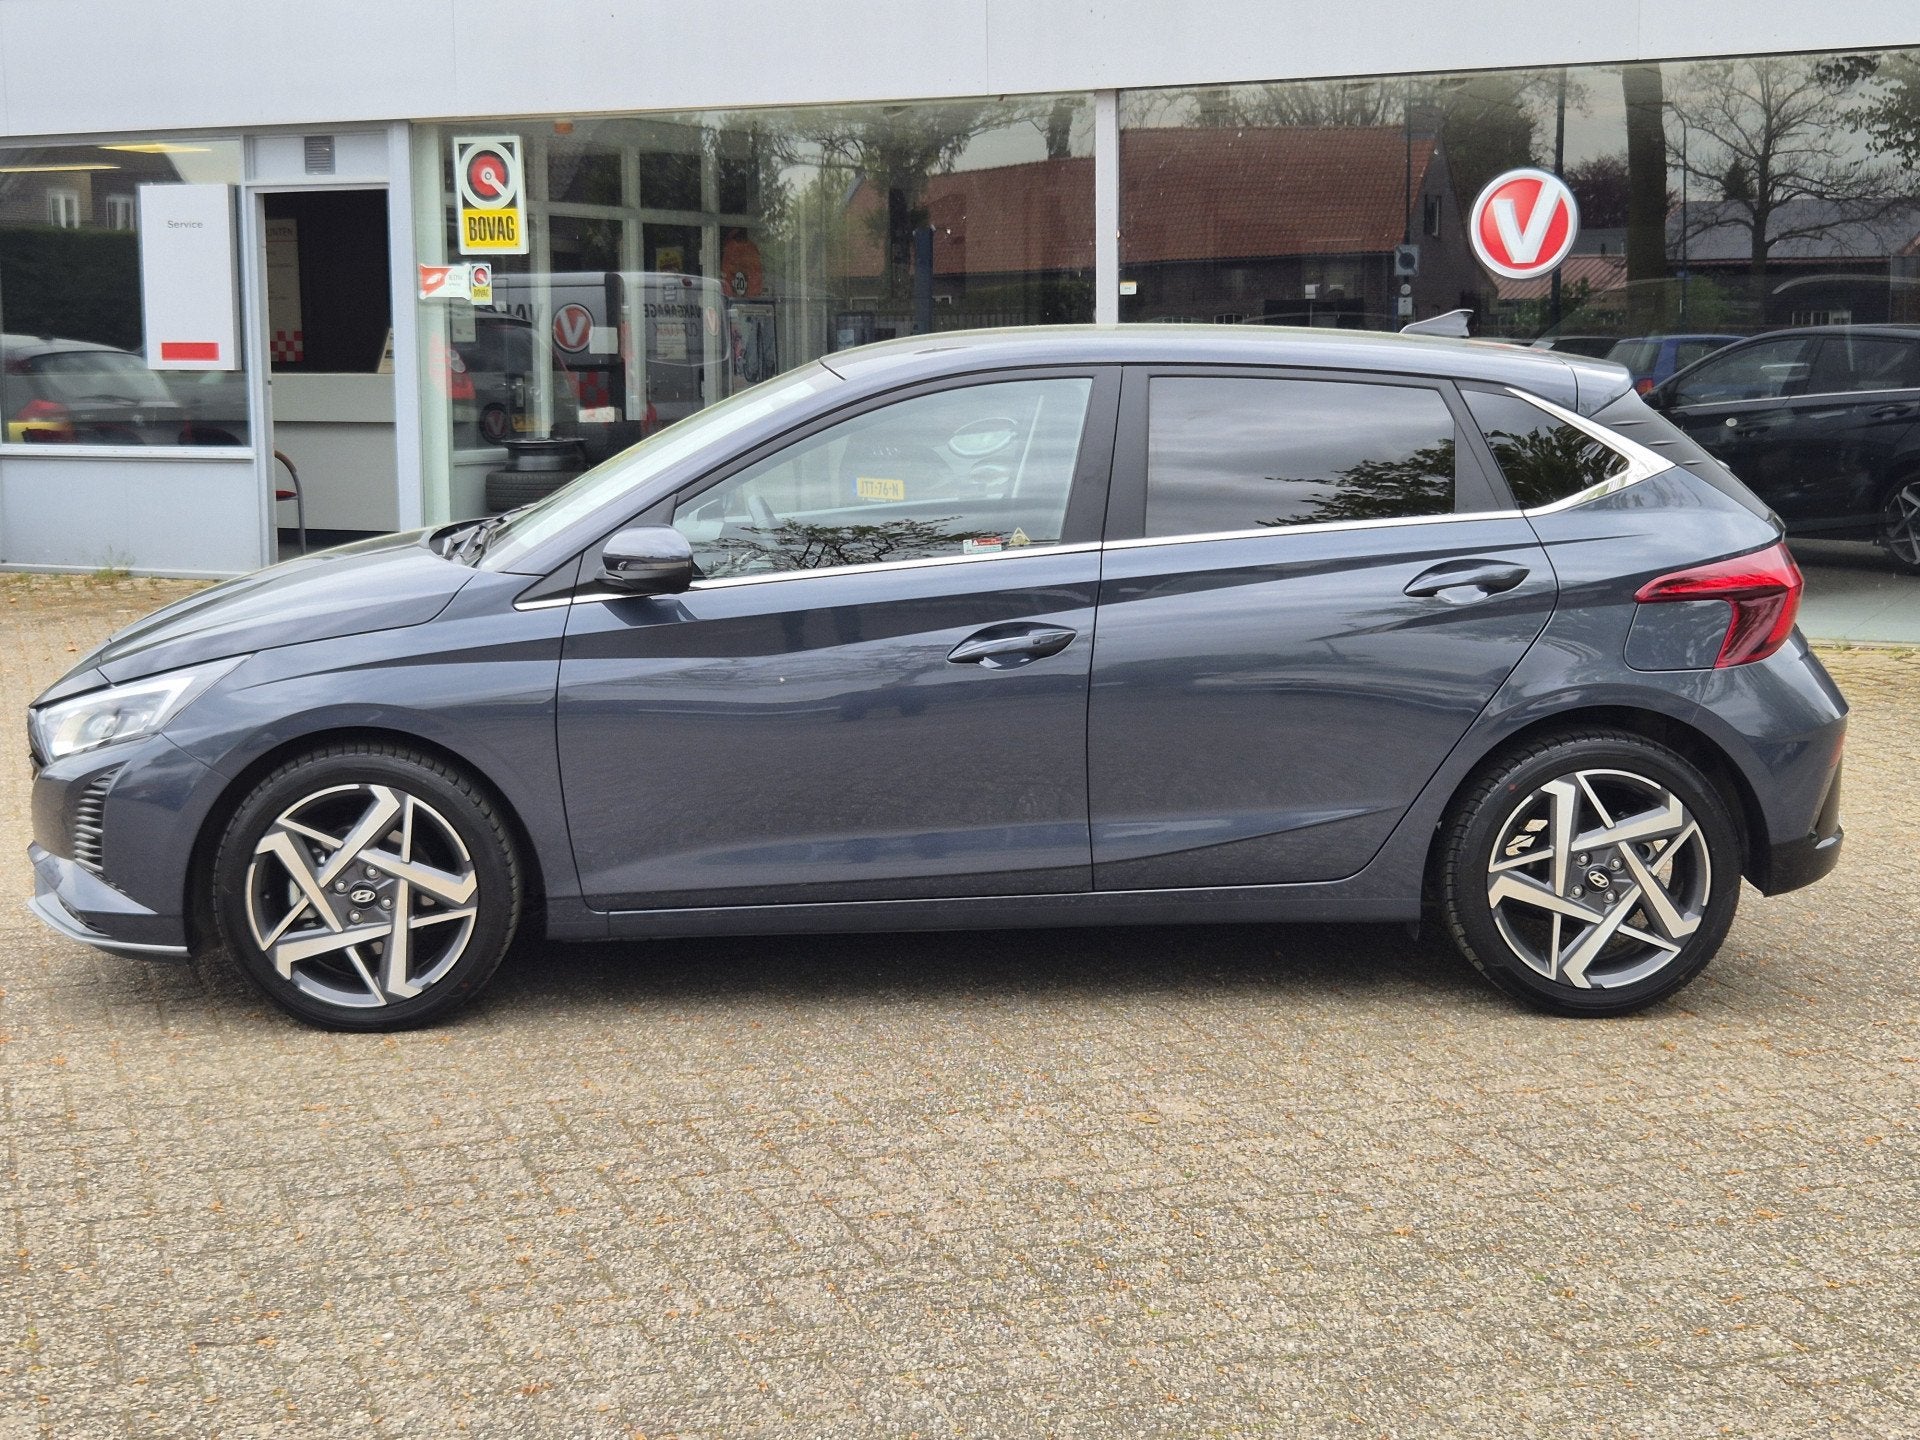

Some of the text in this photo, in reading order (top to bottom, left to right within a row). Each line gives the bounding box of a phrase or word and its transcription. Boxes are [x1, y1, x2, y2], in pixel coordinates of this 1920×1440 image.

[167, 219, 204, 229] Service
[468, 215, 515, 242] BOVAG
[1493, 179, 1560, 264] V
